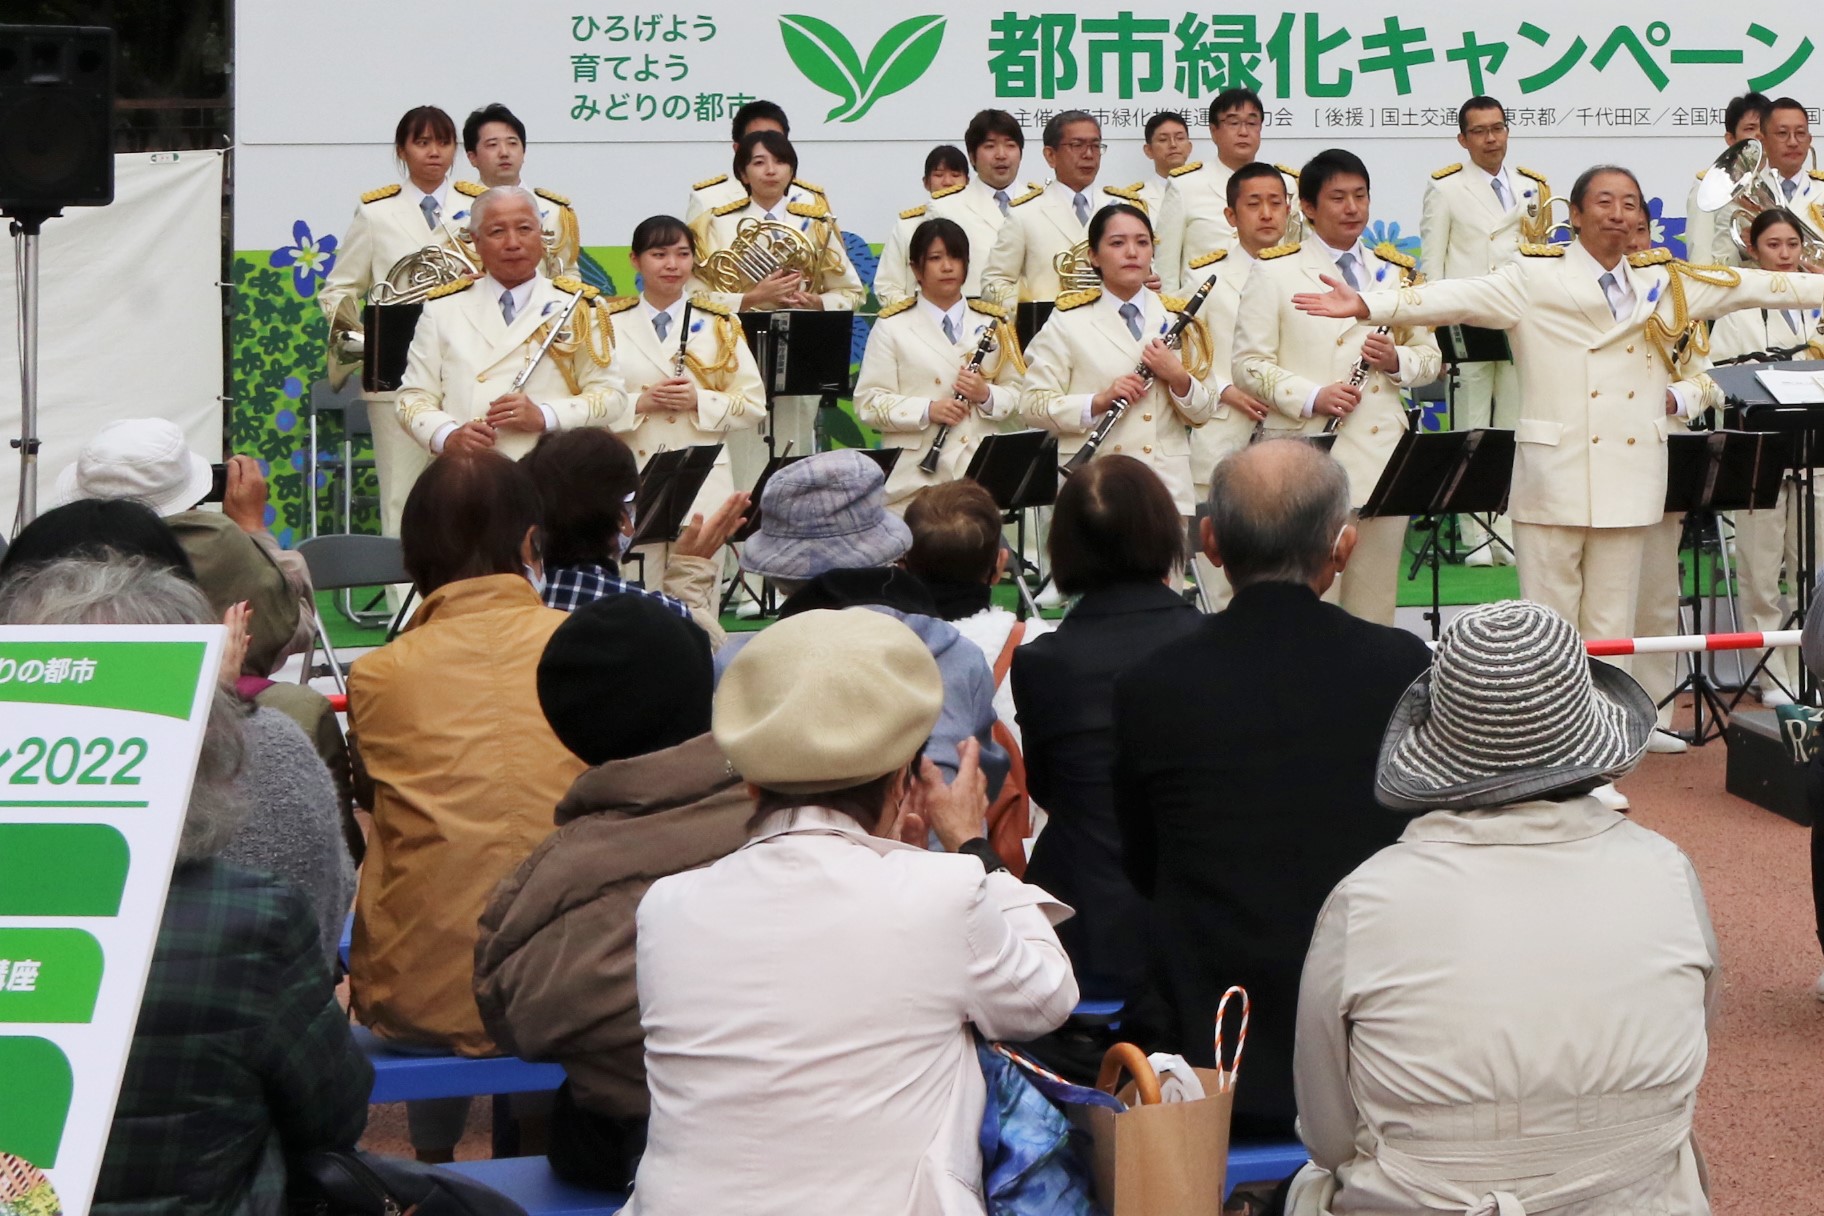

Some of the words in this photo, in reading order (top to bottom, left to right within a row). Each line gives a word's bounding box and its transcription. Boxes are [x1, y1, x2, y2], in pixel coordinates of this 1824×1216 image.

[570, 14, 717, 42] ひろげよう
[570, 53, 689, 83] 育てよう
[988, 11, 1814, 99] 都市緑化キャンペーン
